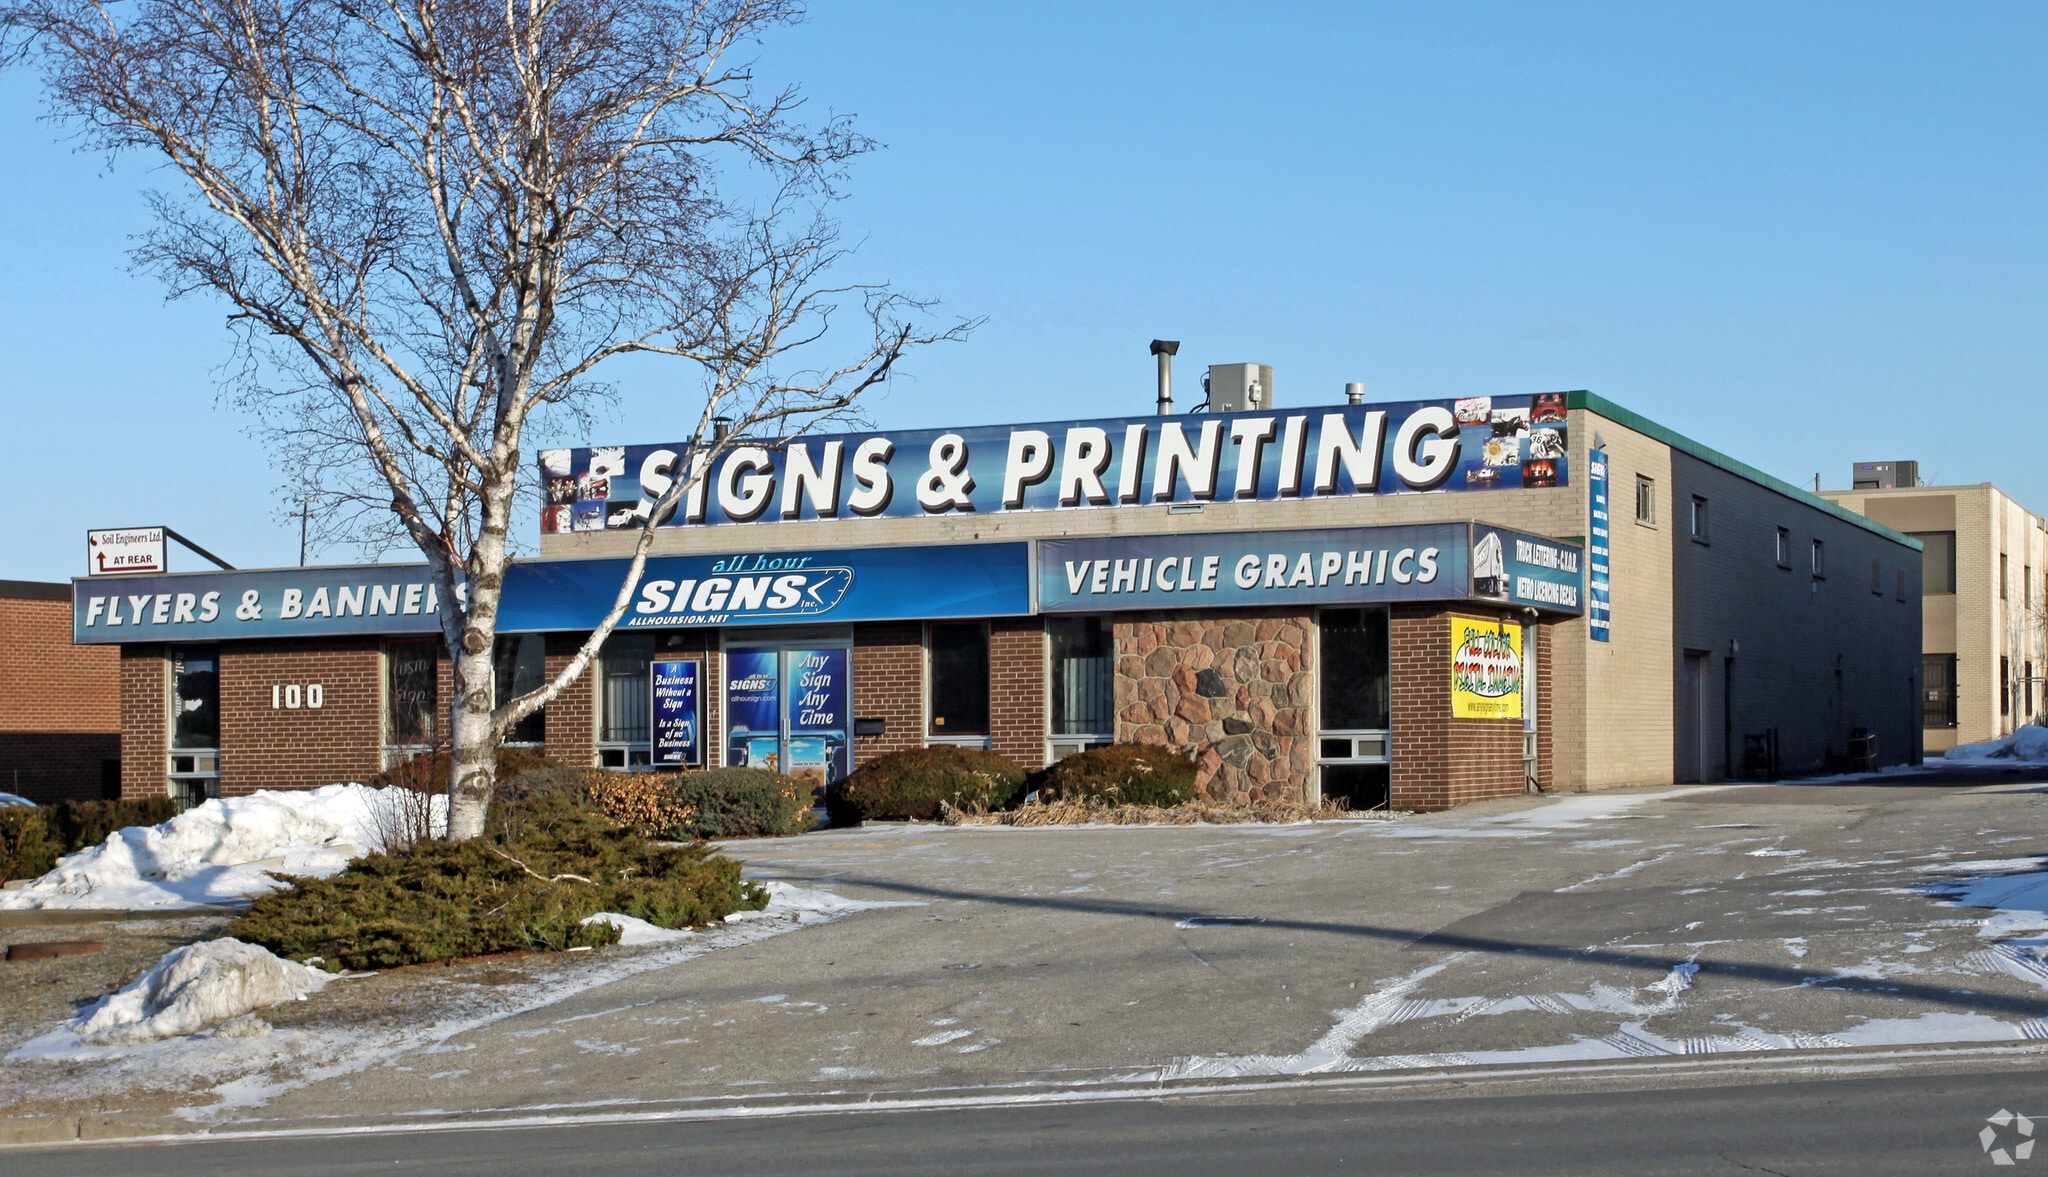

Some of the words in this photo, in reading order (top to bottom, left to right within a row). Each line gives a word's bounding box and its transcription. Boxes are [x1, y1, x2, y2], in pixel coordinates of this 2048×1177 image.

[636, 437, 896, 526] SIGNS
[916, 433, 977, 513] &
[1002, 406, 1461, 511] PRINTING
[102, 533, 114, 545] Soil
[115, 532, 147, 546] Engineers
[149, 531, 162, 543] Ltd.
[113, 555, 125, 565] AT
[128, 554, 153, 564] REAR
[1515, 539, 1533, 565] TRUCK
[1532, 543, 1558, 569] LETTERING
[712, 554, 750, 573] all
[751, 553, 814, 572] hour
[1064, 555, 1221, 595] VEHICLE
[1233, 547, 1441, 590] GRAPHICS
[635, 575, 808, 615] SIGNS
[1516, 576, 1534, 600] METRO
[1534, 579, 1560, 605] LICENCING
[1559, 583, 1577, 607] DECALS
[86, 591, 222, 628] FLYERS
[235, 589, 263, 621] &
[800, 599, 818, 609] Inc.
[627, 614, 730, 627] ALLHOURSIGN.NET
[1464, 626, 1482, 657] FULL
[670, 664, 678, 673] A
[798, 652, 830, 673] Any
[655, 674, 694, 686] Business
[729, 679, 767, 691] SIGNS
[800, 671, 832, 692] Sign
[272, 684, 323, 709] 100
[655, 687, 685, 697] Without
[686, 689, 692, 697] a
[663, 698, 683, 712] Sign
[798, 690, 830, 711] Any
[658, 718, 666, 728] Is
[667, 720, 672, 728] a
[673, 717, 690, 730] Sign
[799, 709, 834, 725] Time
[665, 729, 673, 739] of
[658, 738, 691, 748] Business
